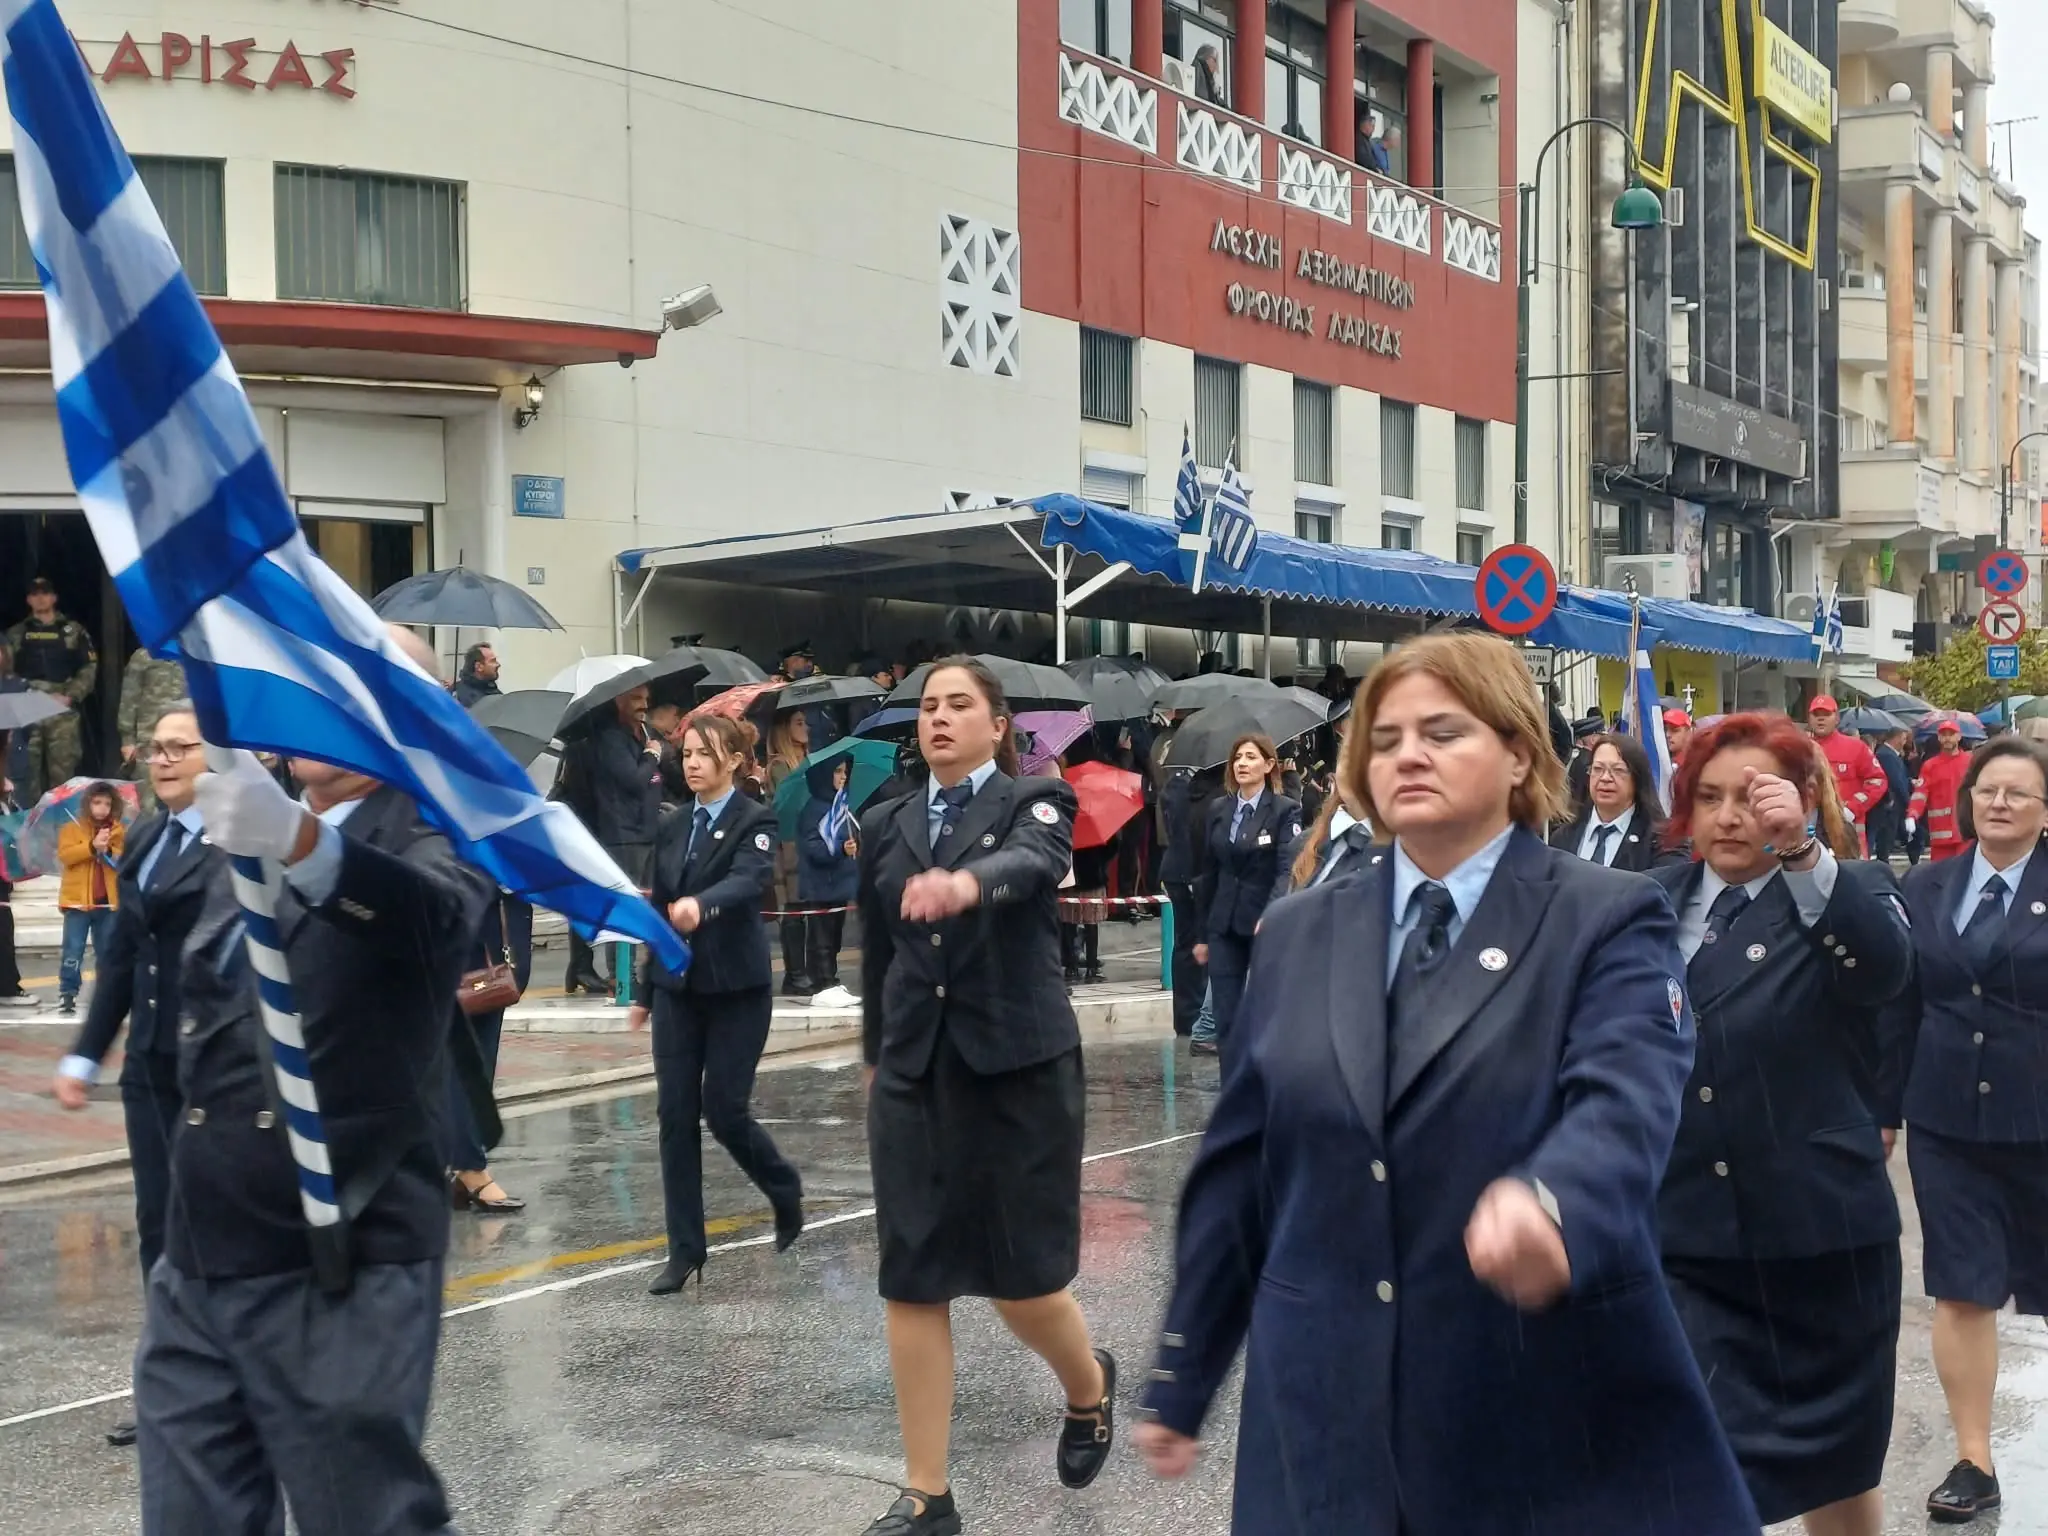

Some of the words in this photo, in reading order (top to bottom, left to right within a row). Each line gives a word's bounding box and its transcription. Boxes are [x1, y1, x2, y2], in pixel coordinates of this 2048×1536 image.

[68, 29, 357, 99] ΑΡΙΣΑΣ
[1770, 36, 1825, 108] ALTERLIFE
[1211, 217, 1282, 269] ΛΕΣΧΗ
[1297, 247, 1415, 310] ΑΞΙΩΜΑΤΙΚΩΝ
[1227, 281, 1316, 337] ΦΡΟΥΡΑΣ
[1327, 311, 1402, 358] ΛΑΡΙΣΑΣ
[525, 490, 556, 500] ΚΥΠΡΟΥ
[527, 480, 553, 489] ΟΔΟΣ
